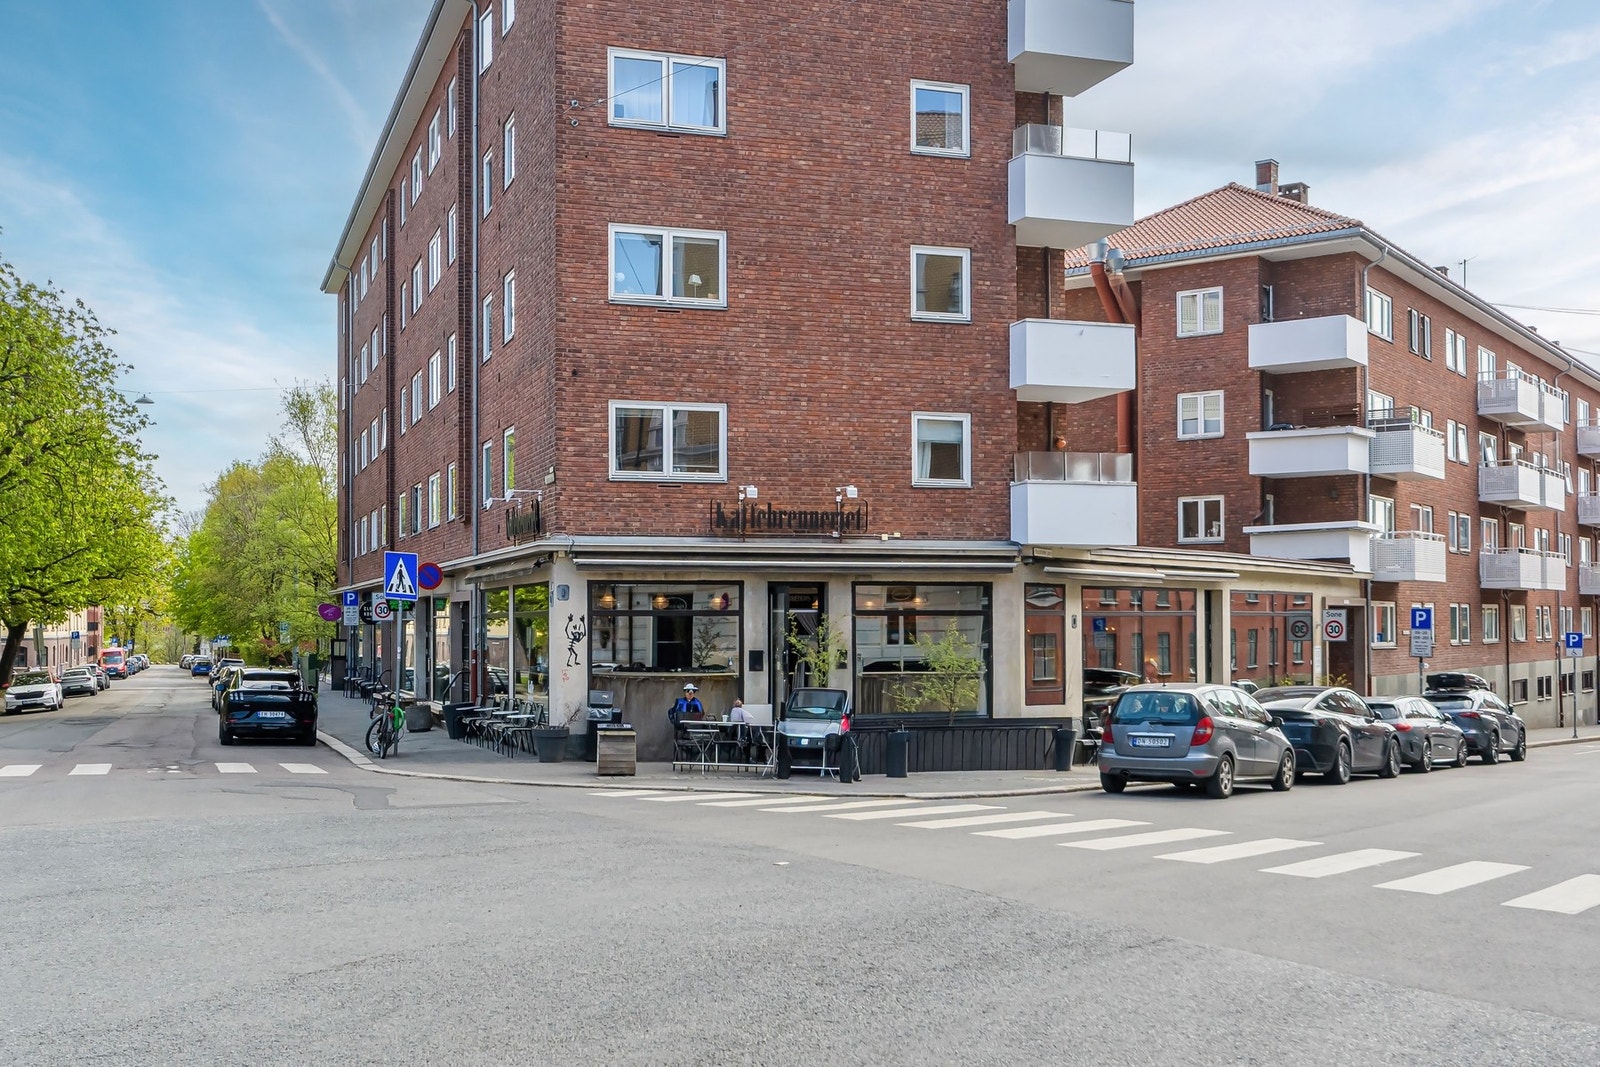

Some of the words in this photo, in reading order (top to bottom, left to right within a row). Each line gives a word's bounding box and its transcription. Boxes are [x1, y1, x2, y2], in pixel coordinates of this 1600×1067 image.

[347, 593, 355, 604] P
[378, 606, 389, 615] 30
[1415, 611, 1427, 627] P
[1328, 625, 1340, 634] 30
[1570, 634, 1579, 646] P
